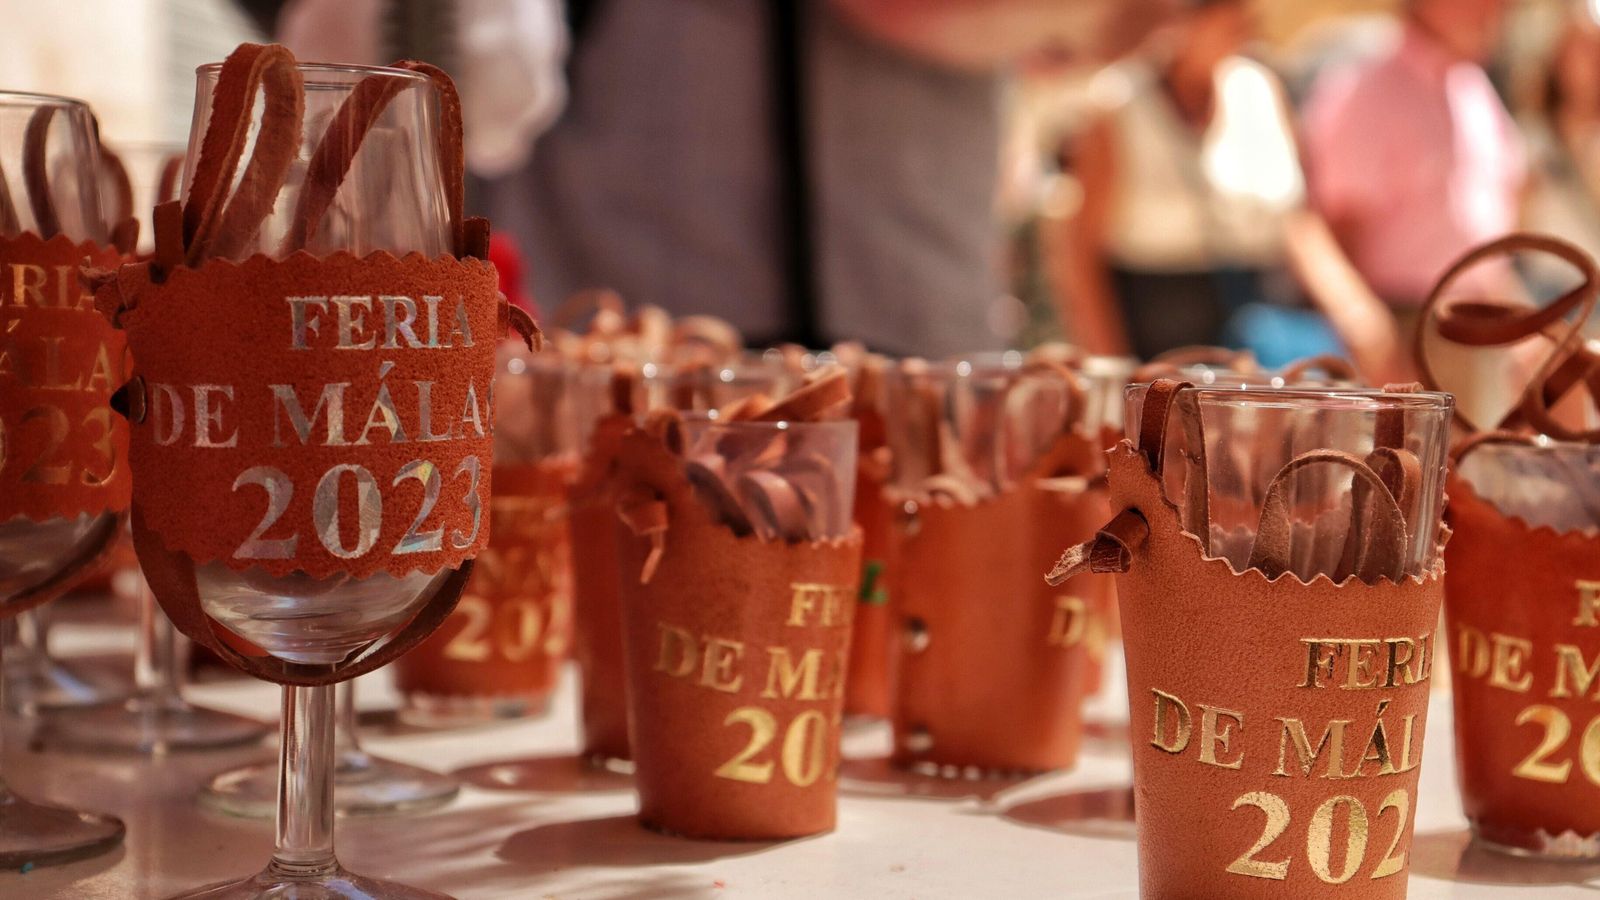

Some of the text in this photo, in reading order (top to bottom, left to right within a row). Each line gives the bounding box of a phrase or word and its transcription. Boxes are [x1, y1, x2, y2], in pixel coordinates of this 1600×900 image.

[285, 295, 475, 350] FERIA
[152, 361, 496, 448] DE MÁLA
[0, 405, 116, 487] 23
[232, 455, 482, 559] 2023
[655, 622, 745, 694] DE
[1457, 624, 1534, 692] DE
[714, 706, 828, 788] 20
[1151, 687, 1246, 770] DE
[1226, 788, 1409, 885] 202
